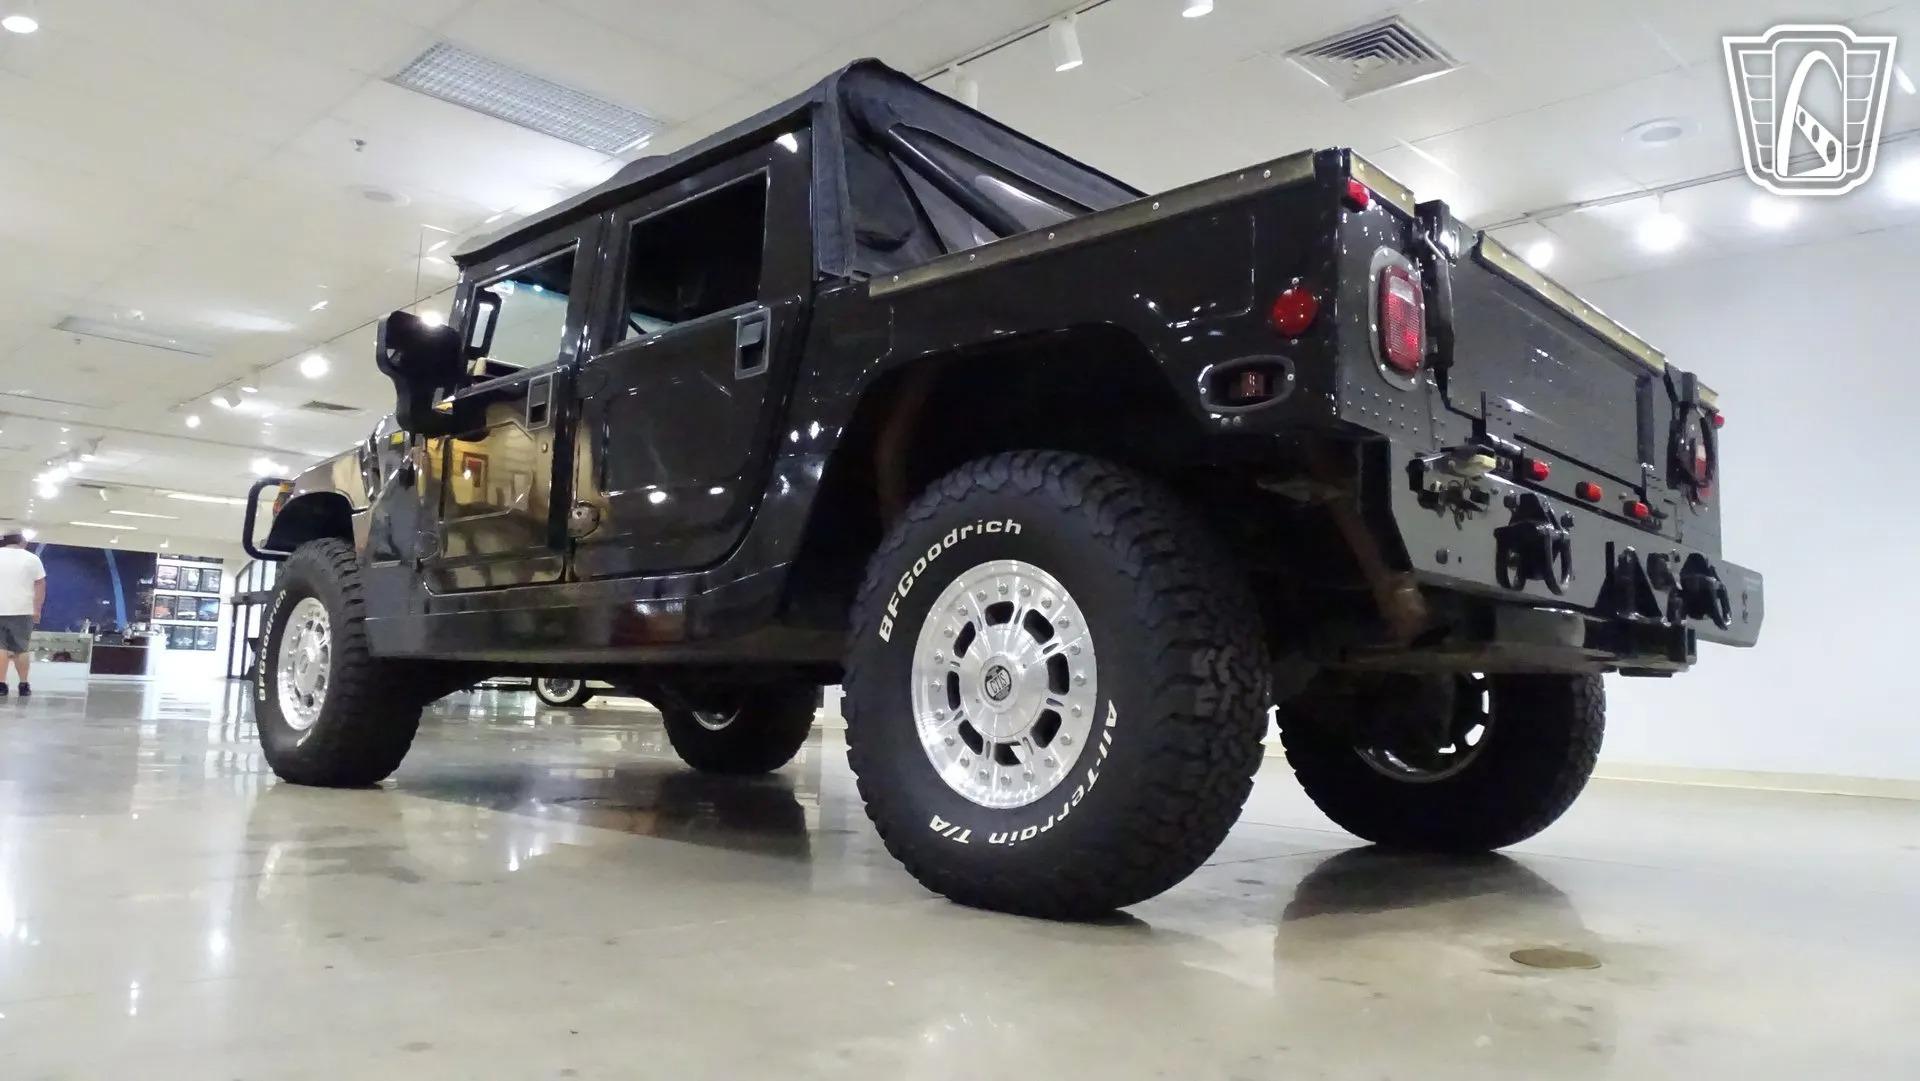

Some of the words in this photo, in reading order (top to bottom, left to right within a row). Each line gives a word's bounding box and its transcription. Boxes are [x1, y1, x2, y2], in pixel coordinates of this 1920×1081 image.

[879, 518, 1022, 642] BFGoodrich
[929, 814, 973, 844] T/A
[988, 699, 1118, 846] All-Terrain
